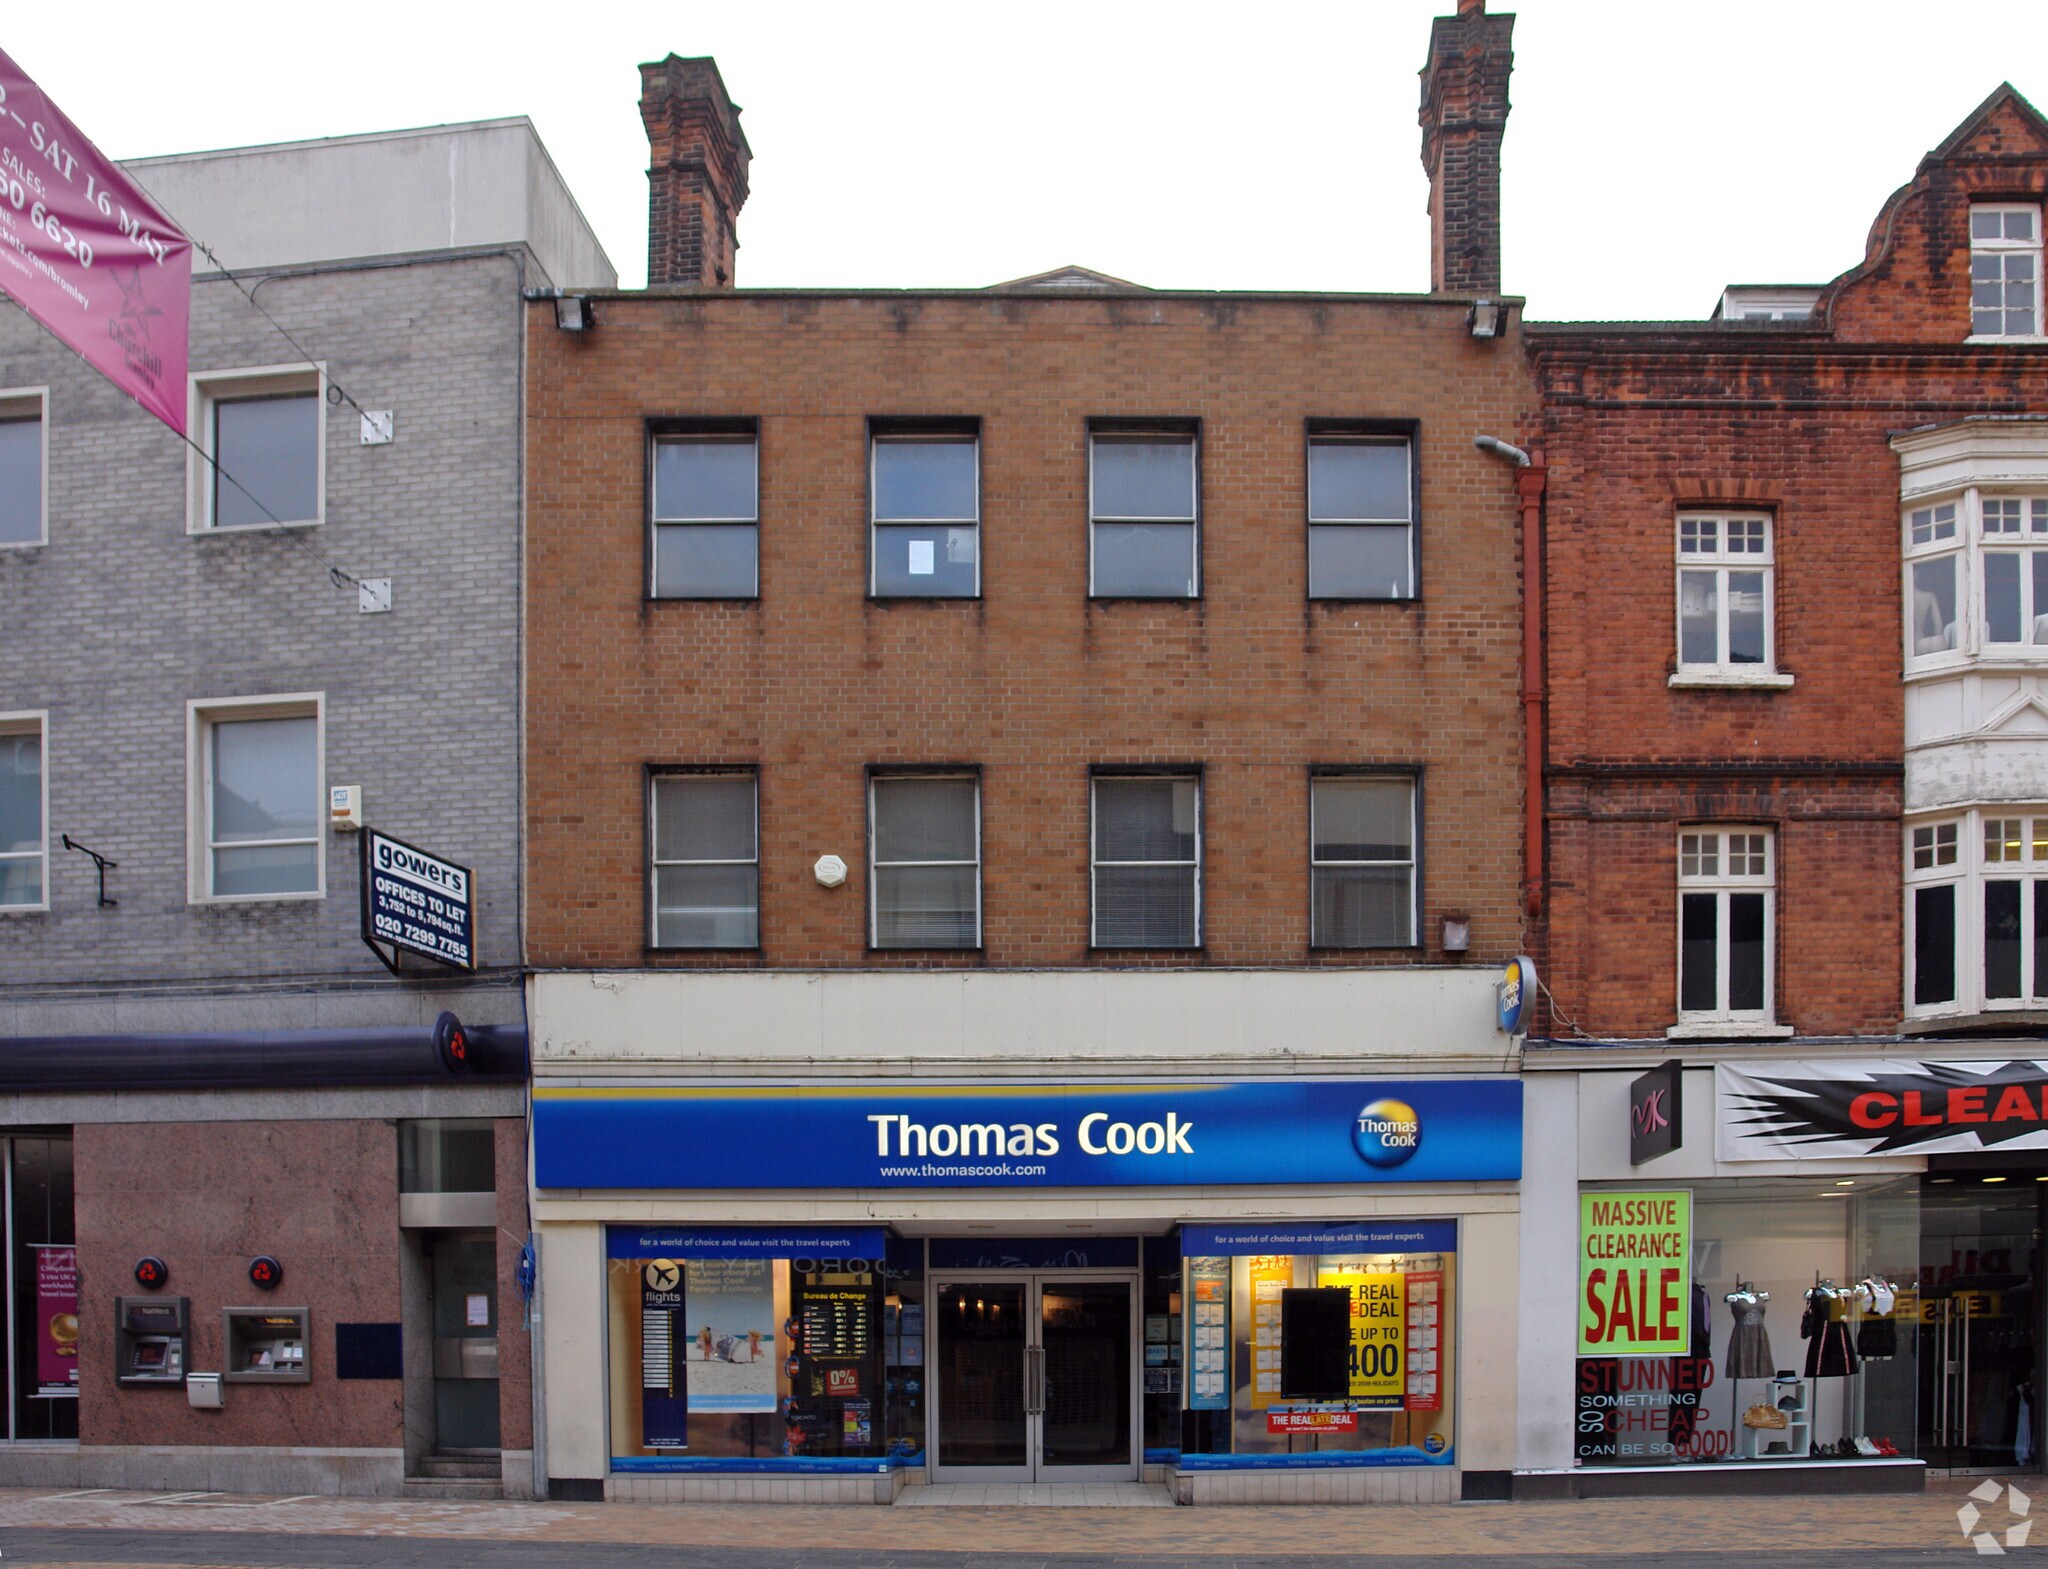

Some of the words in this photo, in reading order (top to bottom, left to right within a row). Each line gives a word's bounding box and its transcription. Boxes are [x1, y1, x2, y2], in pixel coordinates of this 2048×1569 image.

[2, 147, 45, 200] SALES:
[30, 120, 78, 183] SAT
[83, 173, 111, 216] 16
[118, 204, 169, 266] MAY
[31, 201, 93, 268] 6620
[378, 843, 462, 890] gowers
[375, 876, 426, 908] OFFICES
[428, 896, 444, 914] TO
[446, 903, 466, 924] LET
[379, 895, 405, 914] 3,752
[406, 905, 416, 918] to
[375, 914, 402, 934] 020
[404, 923, 436, 947] 7299
[438, 936, 467, 958] 7755
[867, 1114, 1060, 1157] Thomas
[1077, 1112, 1194, 1155] Cook
[1357, 1119, 1417, 1133] Thomas
[1381, 1133, 1416, 1147] Cook
[880, 1163, 1046, 1177] www.thomascook.com
[1592, 1200, 1676, 1226] MASSIVE
[640, 1238, 651, 1246] for
[659, 1238, 683, 1246] world
[684, 1238, 693, 1246] of
[694, 1238, 719, 1246] choice
[721, 1238, 737, 1246] and
[738, 1238, 760, 1246] value
[820, 1239, 851, 1248] experts
[1215, 1236, 1226, 1244] for
[1235, 1235, 1258, 1243] world
[1259, 1235, 1268, 1243] of
[1270, 1234, 1295, 1243] choice
[1297, 1234, 1312, 1242] and
[1313, 1234, 1335, 1242] value
[1337, 1234, 1354, 1242] visit
[1355, 1233, 1369, 1241] the
[1370, 1232, 1393, 1241] travel
[1395, 1232, 1424, 1242] experts
[1587, 1232, 1681, 1259] CLEARANCE
[645, 1291, 681, 1304] flights
[803, 1292, 828, 1300] Bureau
[829, 1292, 838, 1300] de
[839, 1292, 866, 1300] Change
[1359, 1284, 1399, 1300] REAL
[142, 1306, 170, 1315] NatWest
[1359, 1302, 1399, 1318] DEAL
[1585, 1268, 1680, 1343] SALE
[1361, 1328, 1377, 1339] UP
[1382, 1327, 1399, 1339] TO
[830, 1369, 855, 1385] 0%
[1580, 1358, 1714, 1393] STUNNED
[1580, 1393, 1696, 1408] SOMETHING
[1272, 1415, 1289, 1424] THE
[1291, 1415, 1312, 1424] REAL
[1312, 1414, 1331, 1425] LATE
[1331, 1414, 1352, 1424] DEAL
[1579, 1411, 1604, 1433] SO
[1604, 1408, 1710, 1433] CHEAP
[1579, 1444, 1616, 1456] CAN
[1621, 1443, 1644, 1454] BE
[1650, 1442, 1674, 1454] SO
[1675, 1429, 1734, 1456] GOOD!
